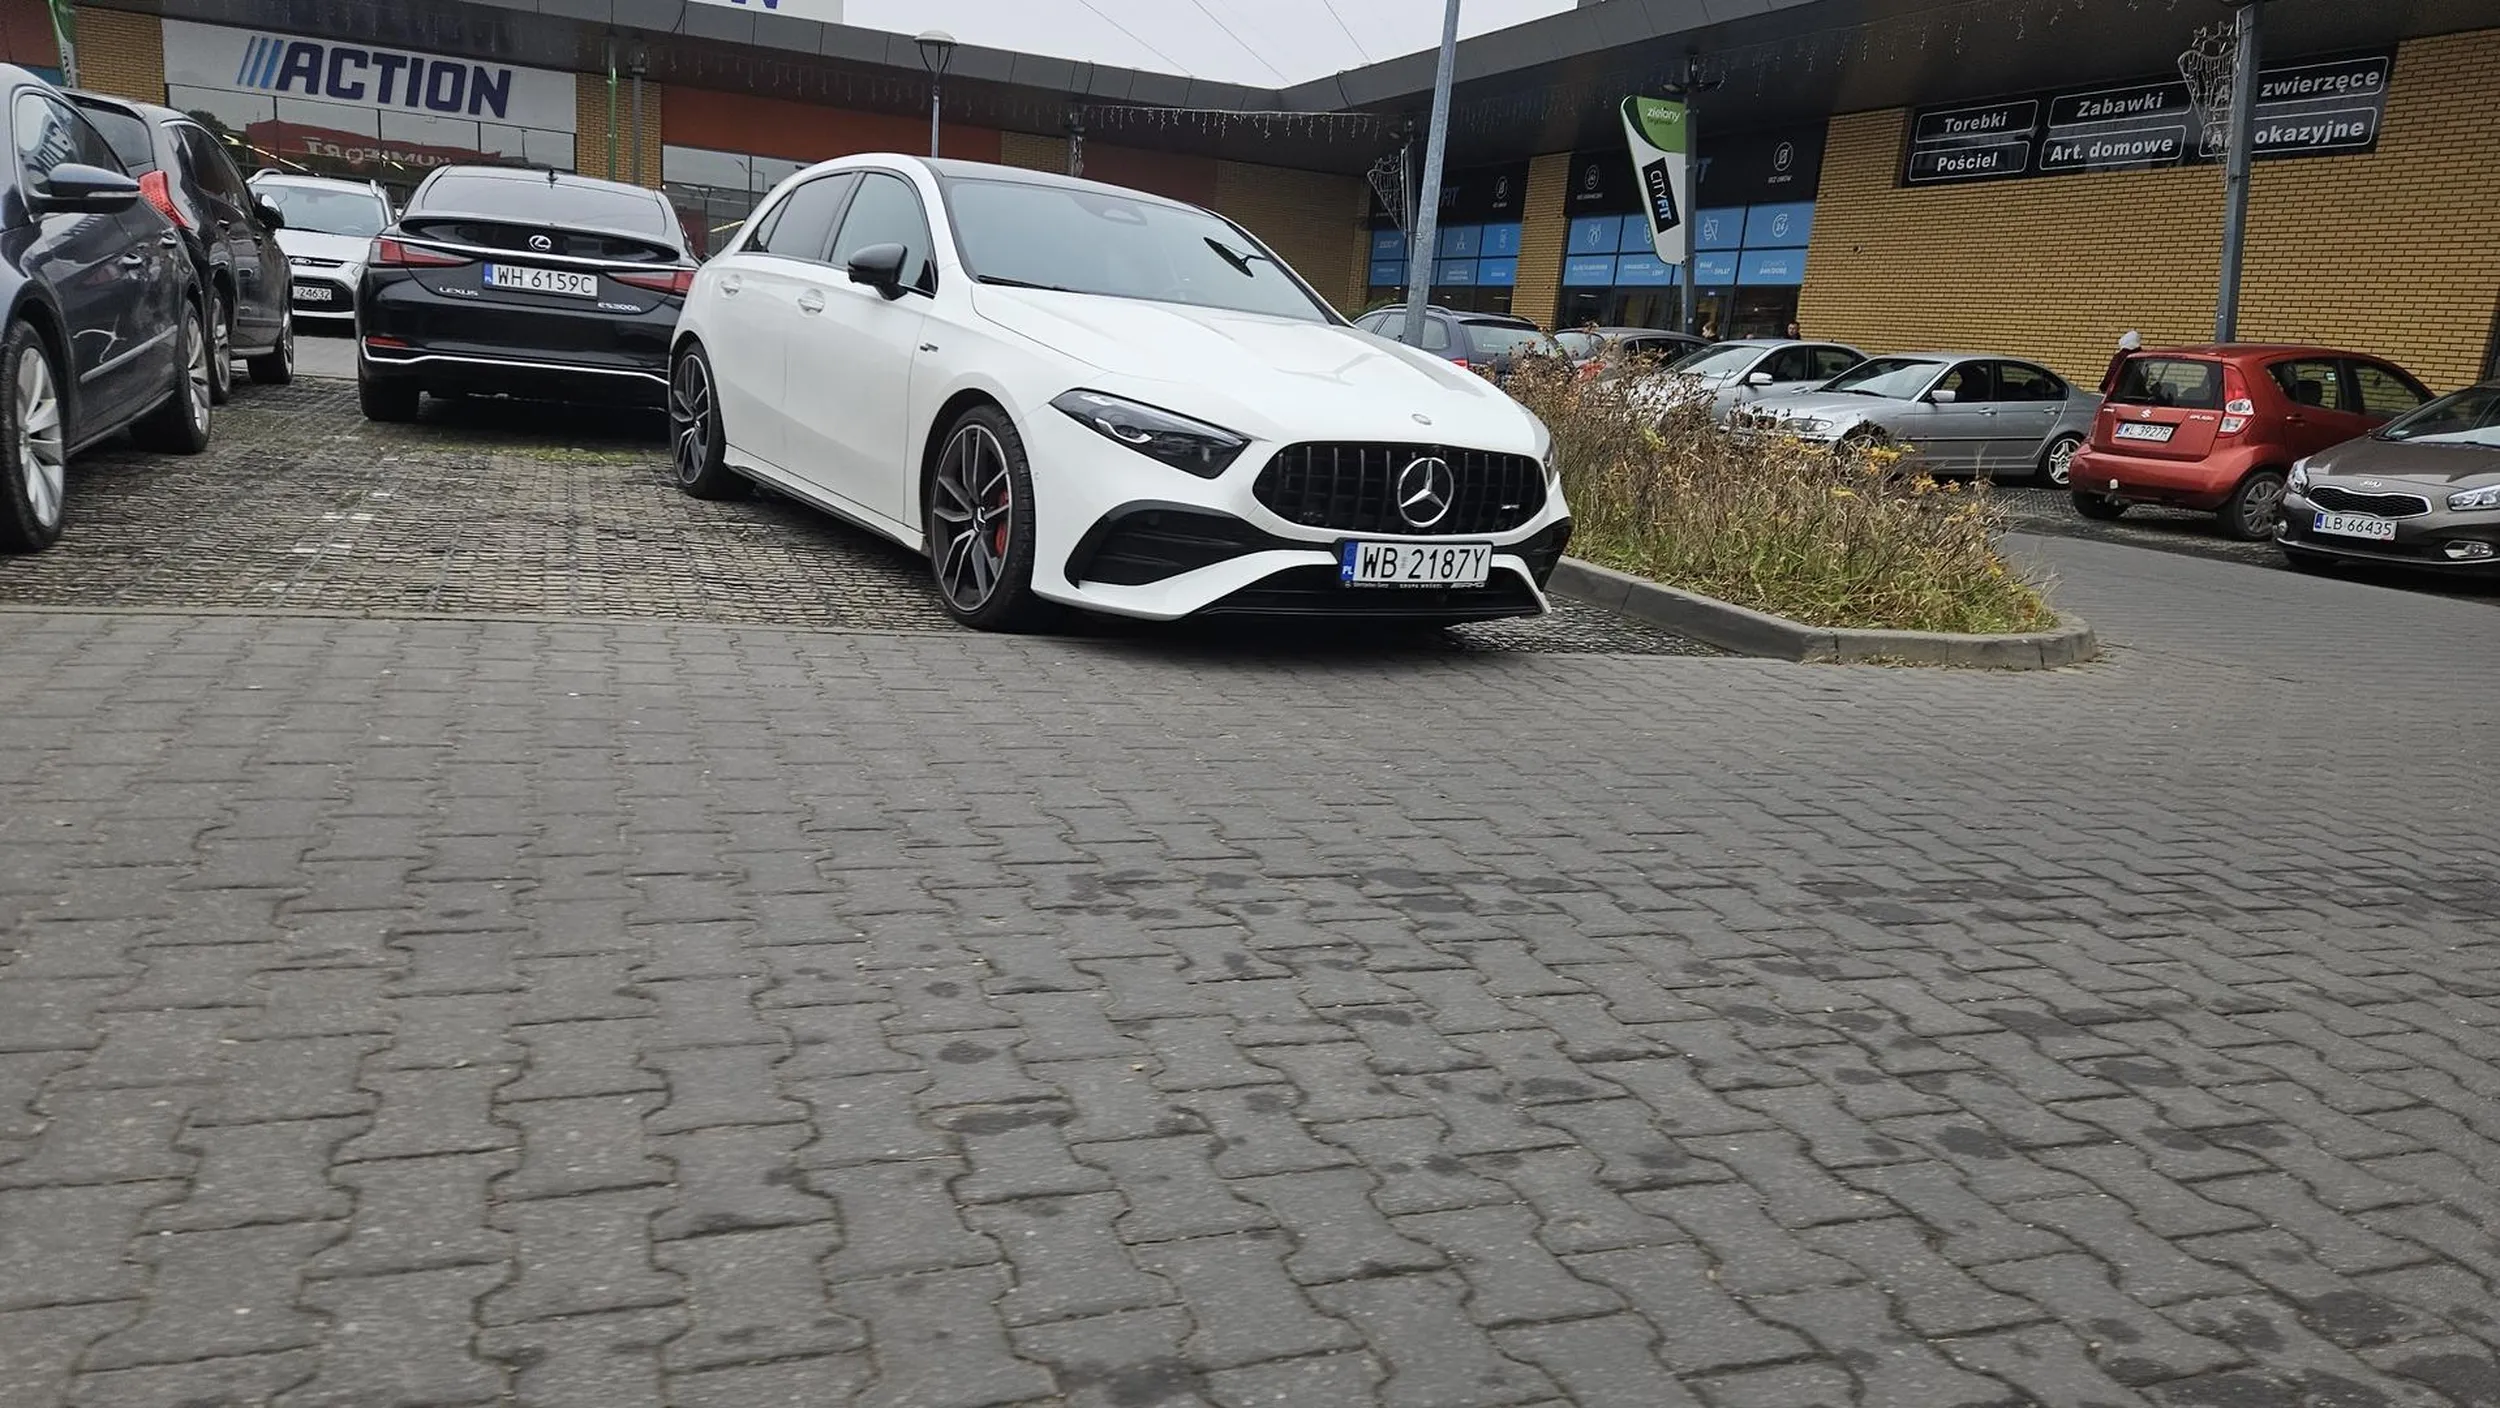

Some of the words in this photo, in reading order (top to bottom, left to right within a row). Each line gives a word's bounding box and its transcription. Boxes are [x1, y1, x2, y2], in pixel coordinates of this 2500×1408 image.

[275, 41, 512, 119] ACTION
[2261, 71, 2380, 98] zwierzęce
[2076, 92, 2164, 118] Zabawki
[1945, 111, 2008, 133] Torebki
[2255, 120, 2365, 144] okazyjne
[1937, 152, 1998, 172] Pościel
[2050, 144, 2083, 161] Art.
[2089, 139, 2173, 158] domowe
[1650, 170, 1672, 220] CITYFIT
[439, 286, 479, 297] LEXUS
[498, 267, 524, 287] WH
[531, 271, 593, 295] 6159C
[2139, 425, 2171, 440] 3927R
[2324, 515, 2343, 531] LB
[2347, 519, 2392, 536] 66435
[1342, 565, 1354, 575] PL
[1362, 546, 1398, 579] WB
[1408, 548, 1486, 580] 2187Y
